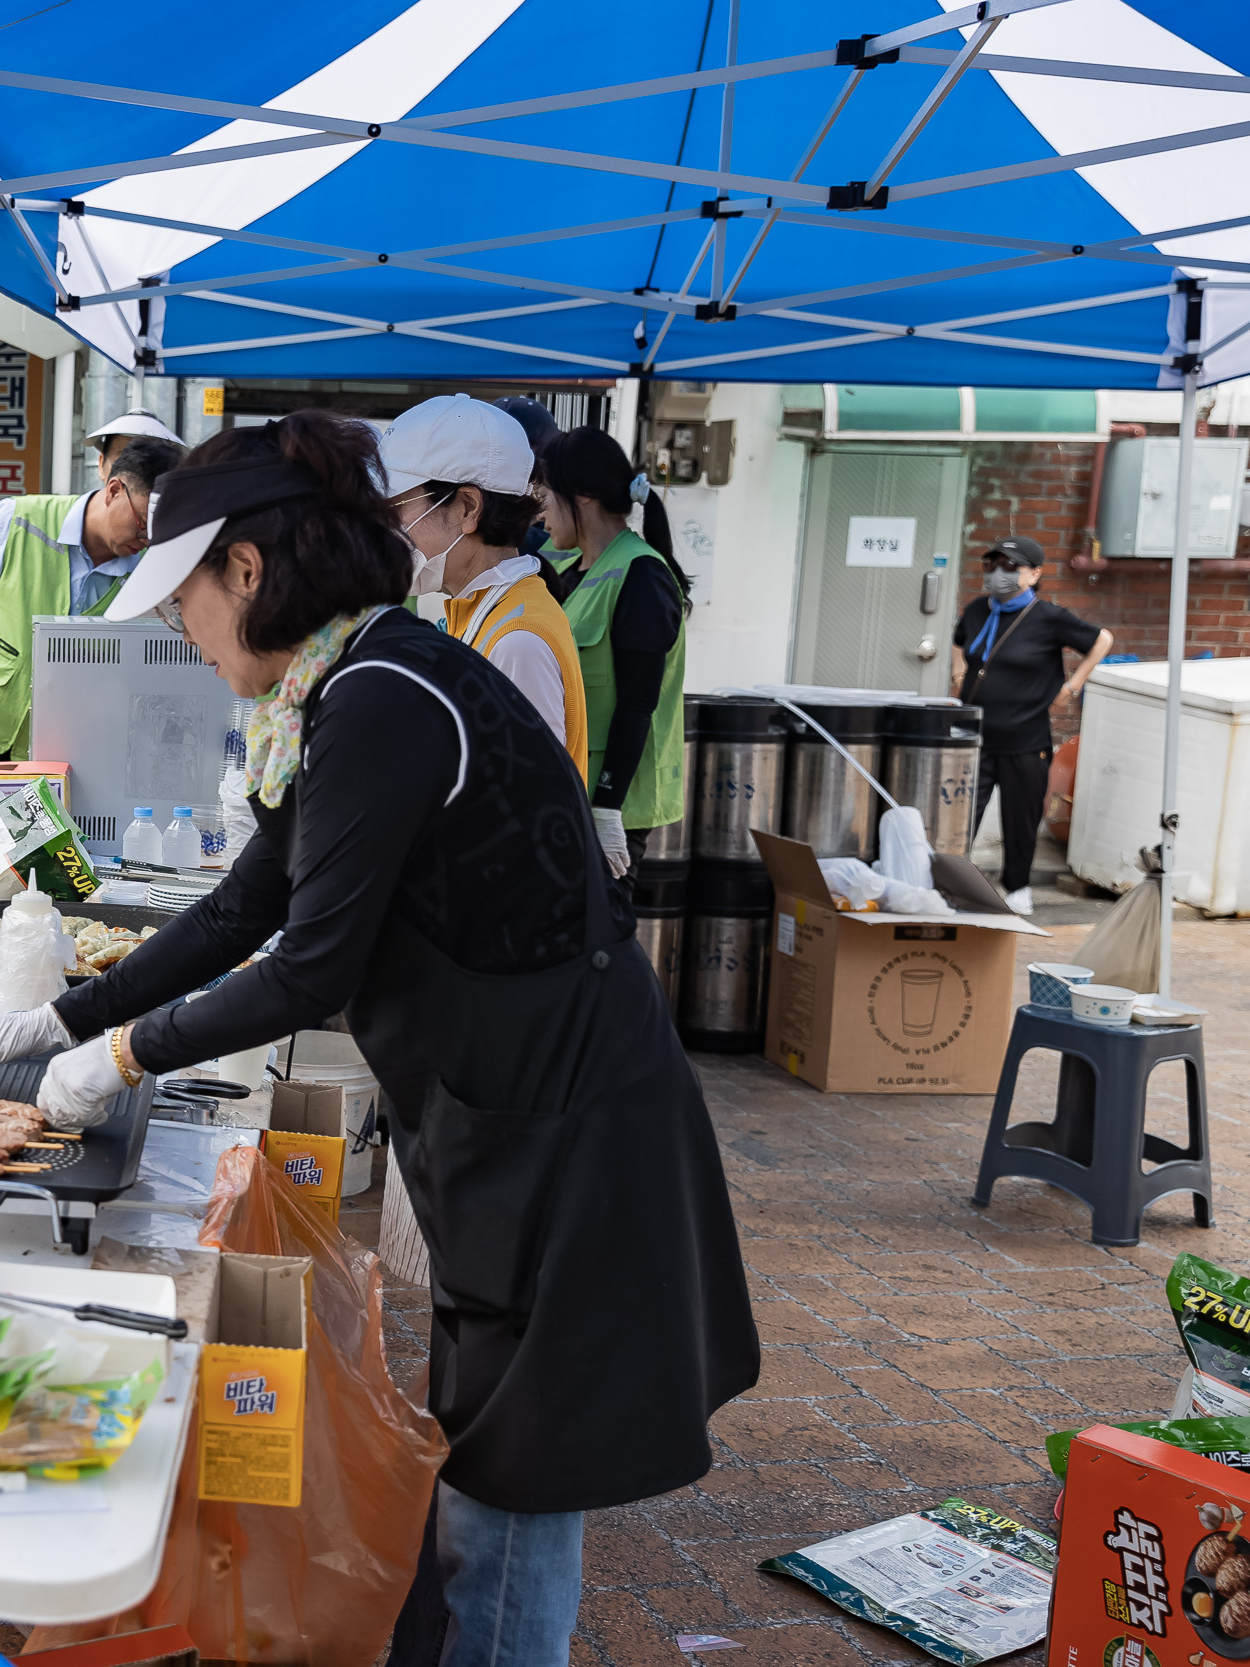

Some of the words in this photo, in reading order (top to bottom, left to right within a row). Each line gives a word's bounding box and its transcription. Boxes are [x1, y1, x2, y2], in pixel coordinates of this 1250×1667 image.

[877, 1077, 894, 1085] PLA
[283, 1156, 317, 1175] 비타
[291, 1167, 324, 1187] 파워
[1212, 1353, 1237, 1369] bibigo
[224, 1376, 268, 1402] 비타
[233, 1391, 277, 1416] 파워
